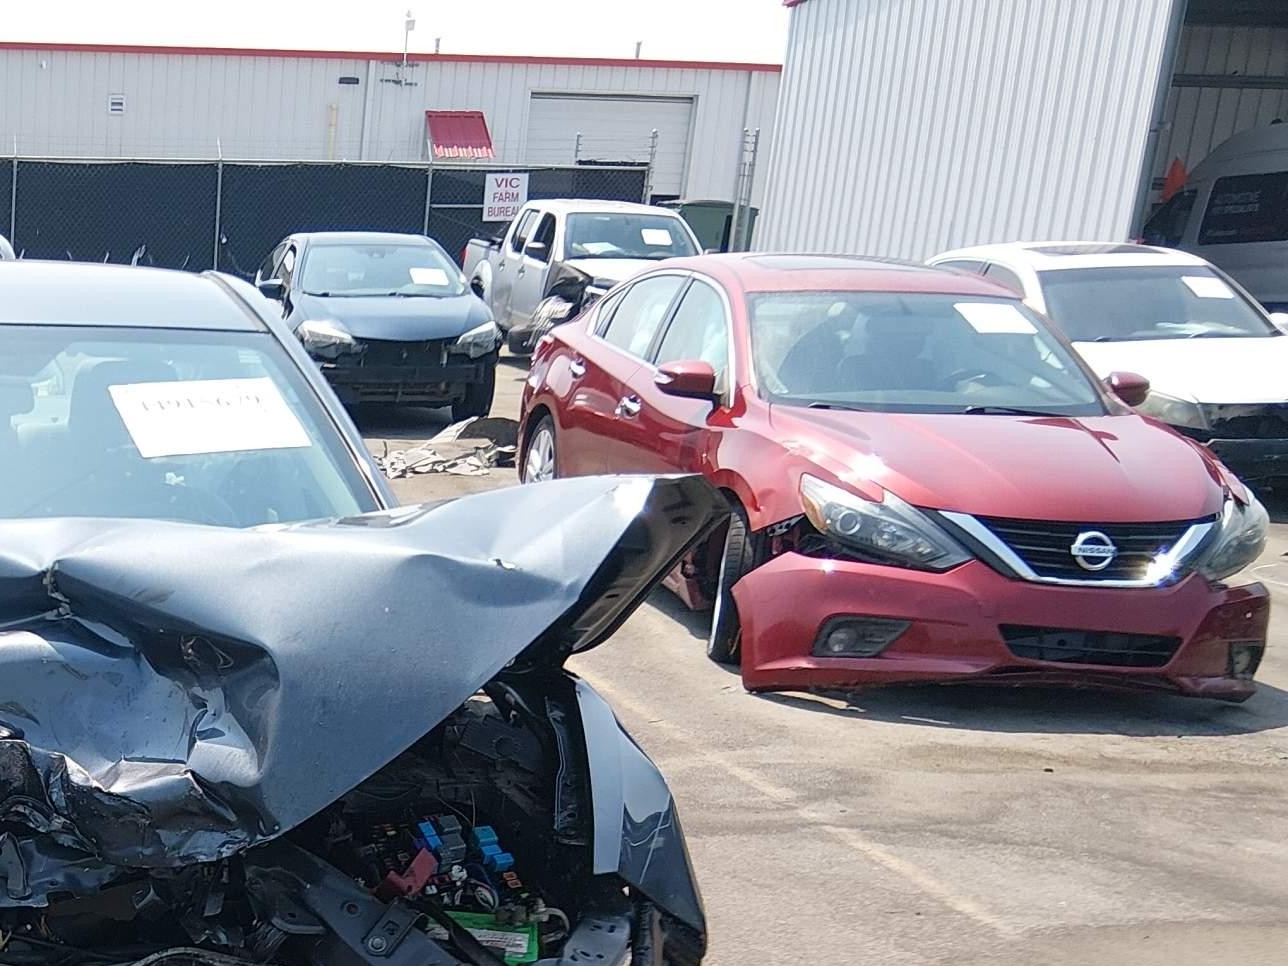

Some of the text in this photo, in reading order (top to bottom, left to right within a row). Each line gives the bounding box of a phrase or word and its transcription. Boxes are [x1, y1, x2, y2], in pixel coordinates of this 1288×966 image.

[494, 177, 521, 189] VIC
[492, 192, 520, 203] FARM
[1076, 546, 1114, 555] NISSAN
